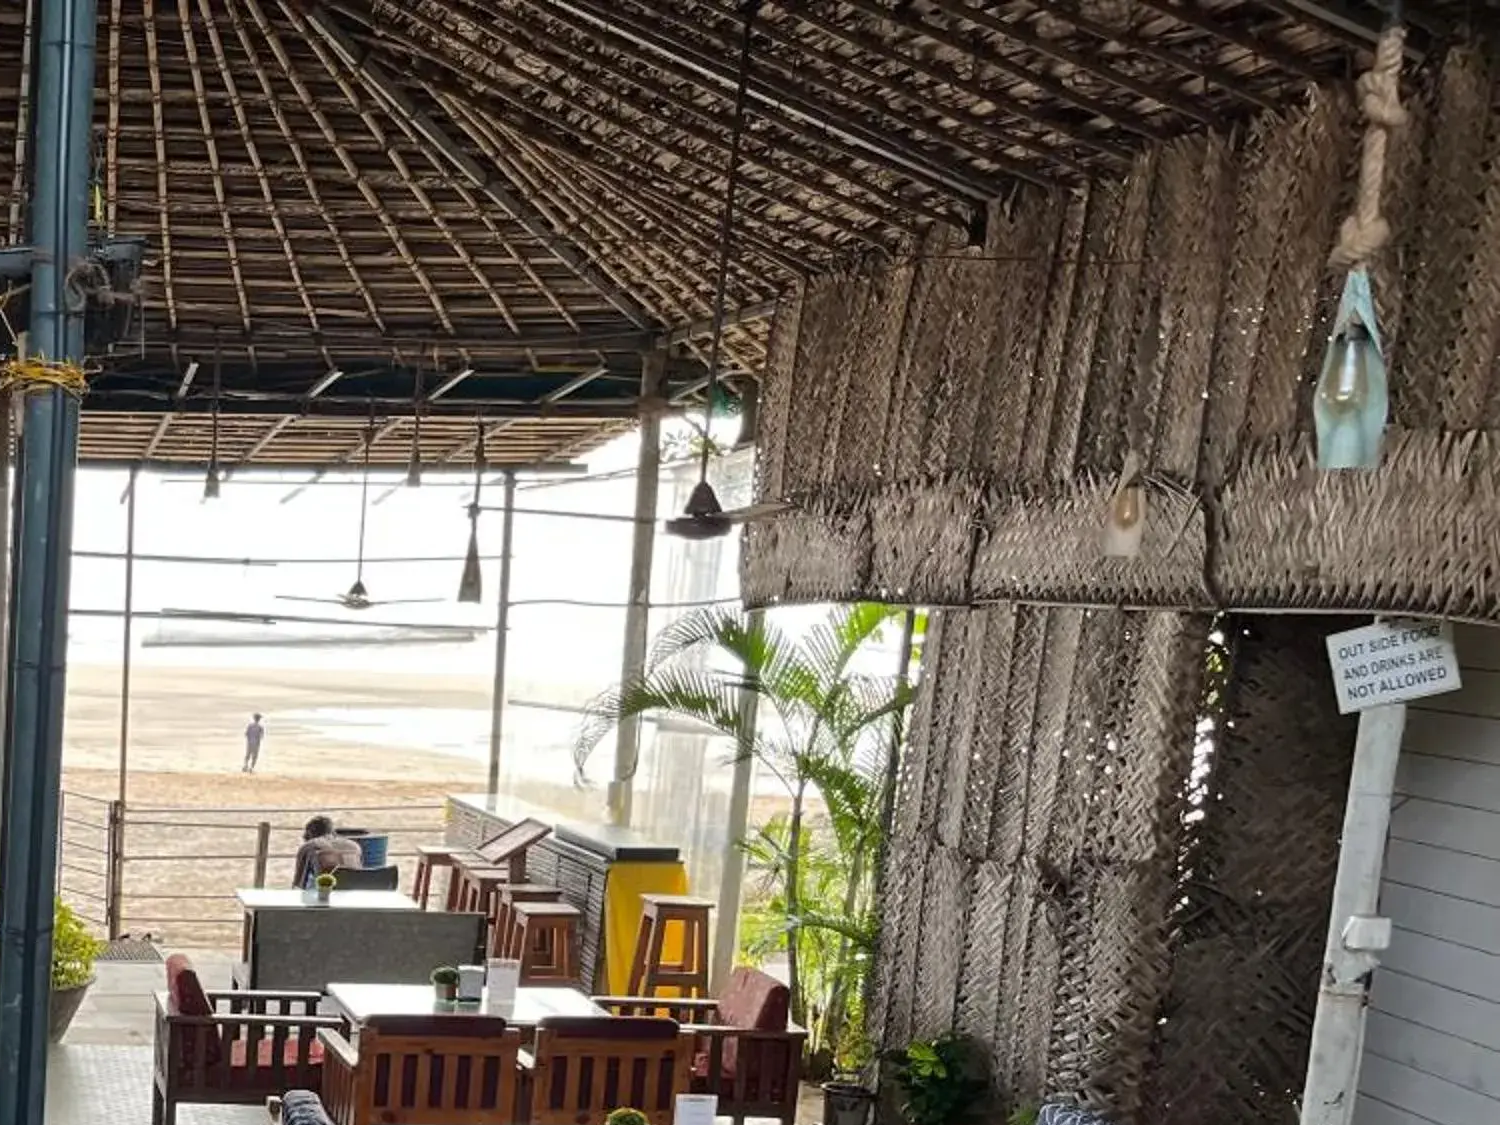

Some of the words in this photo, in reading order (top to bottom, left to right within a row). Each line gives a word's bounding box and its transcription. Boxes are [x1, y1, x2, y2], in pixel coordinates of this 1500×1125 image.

[1338, 643, 1365, 660] OUT
[1369, 636, 1401, 653] SIDE
[1344, 665, 1369, 680] AND
[1371, 653, 1416, 675] DRINKS
[1419, 646, 1444, 662] ARE
[1347, 683, 1376, 701] NOT
[1379, 666, 1447, 693] ALLOWED
